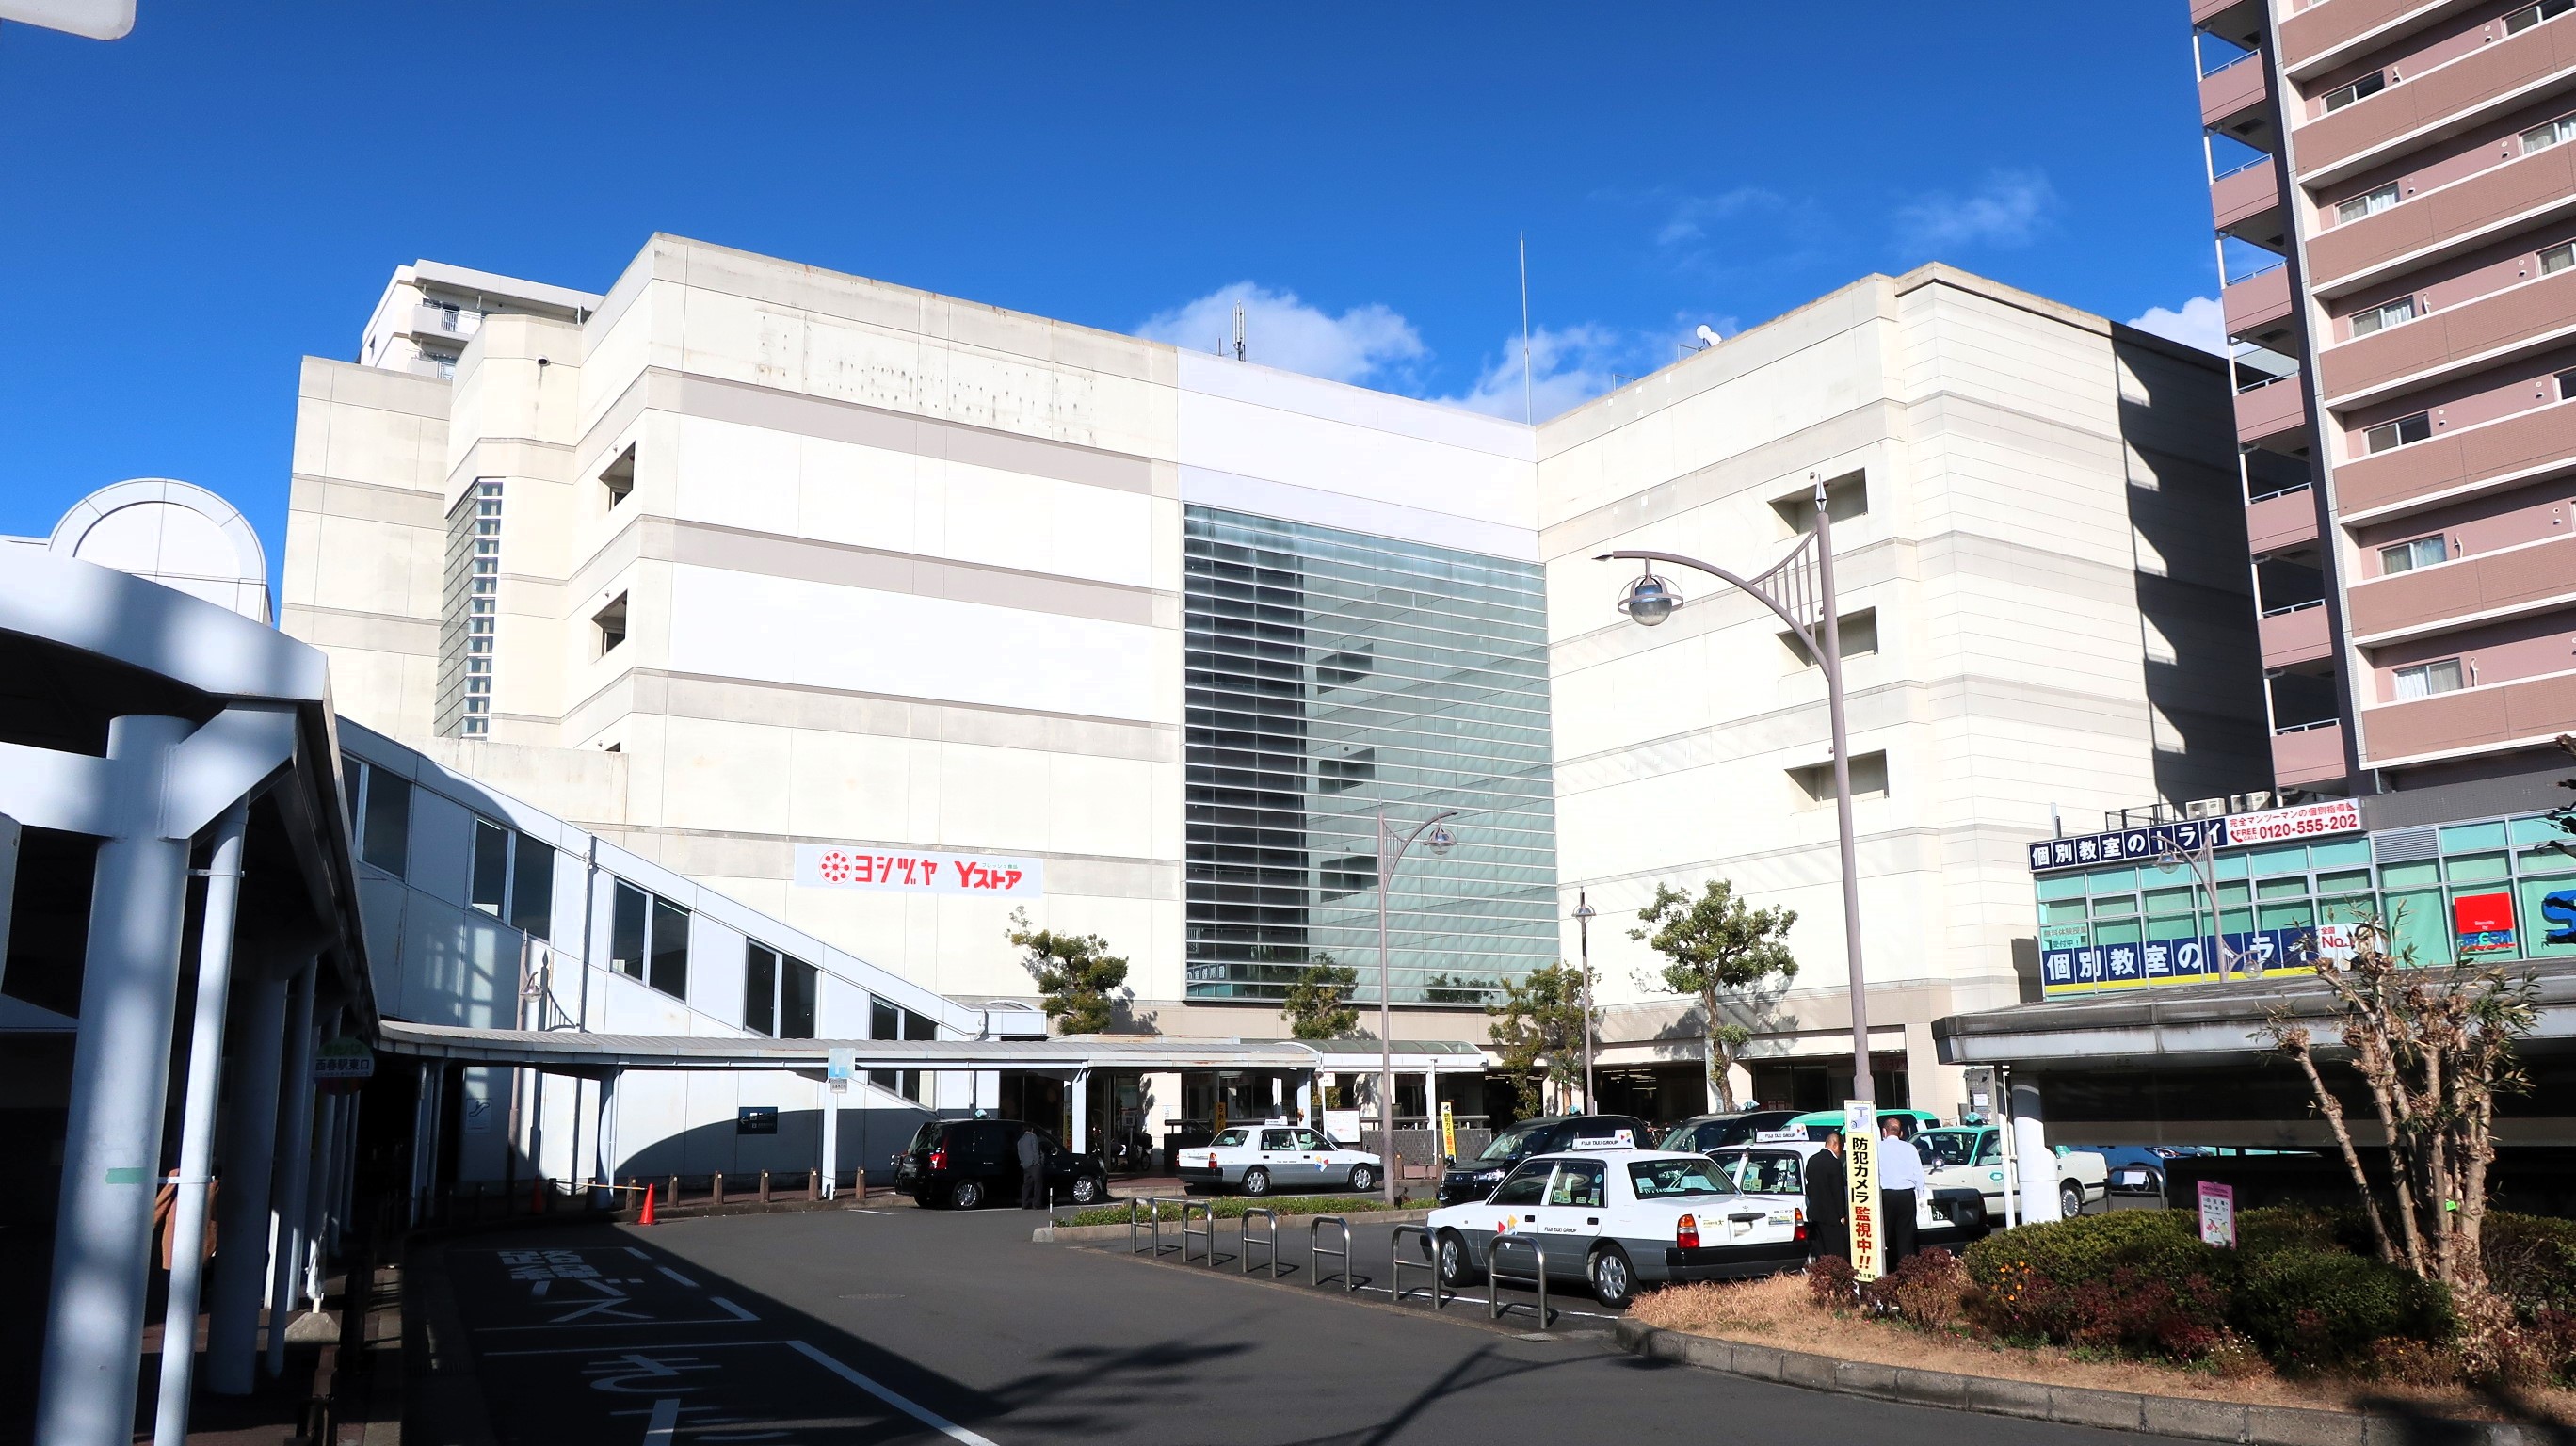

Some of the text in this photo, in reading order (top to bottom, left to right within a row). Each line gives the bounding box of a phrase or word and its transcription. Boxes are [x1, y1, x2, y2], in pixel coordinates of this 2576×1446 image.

[2260, 814, 2358, 839] 0120-555-202
[954, 860, 1022, 890] Yストア
[2321, 926, 2336, 935] 全国
[2047, 935, 2309, 981] 個別教室のラ
[315, 1058, 370, 1071] 西春駅東口
